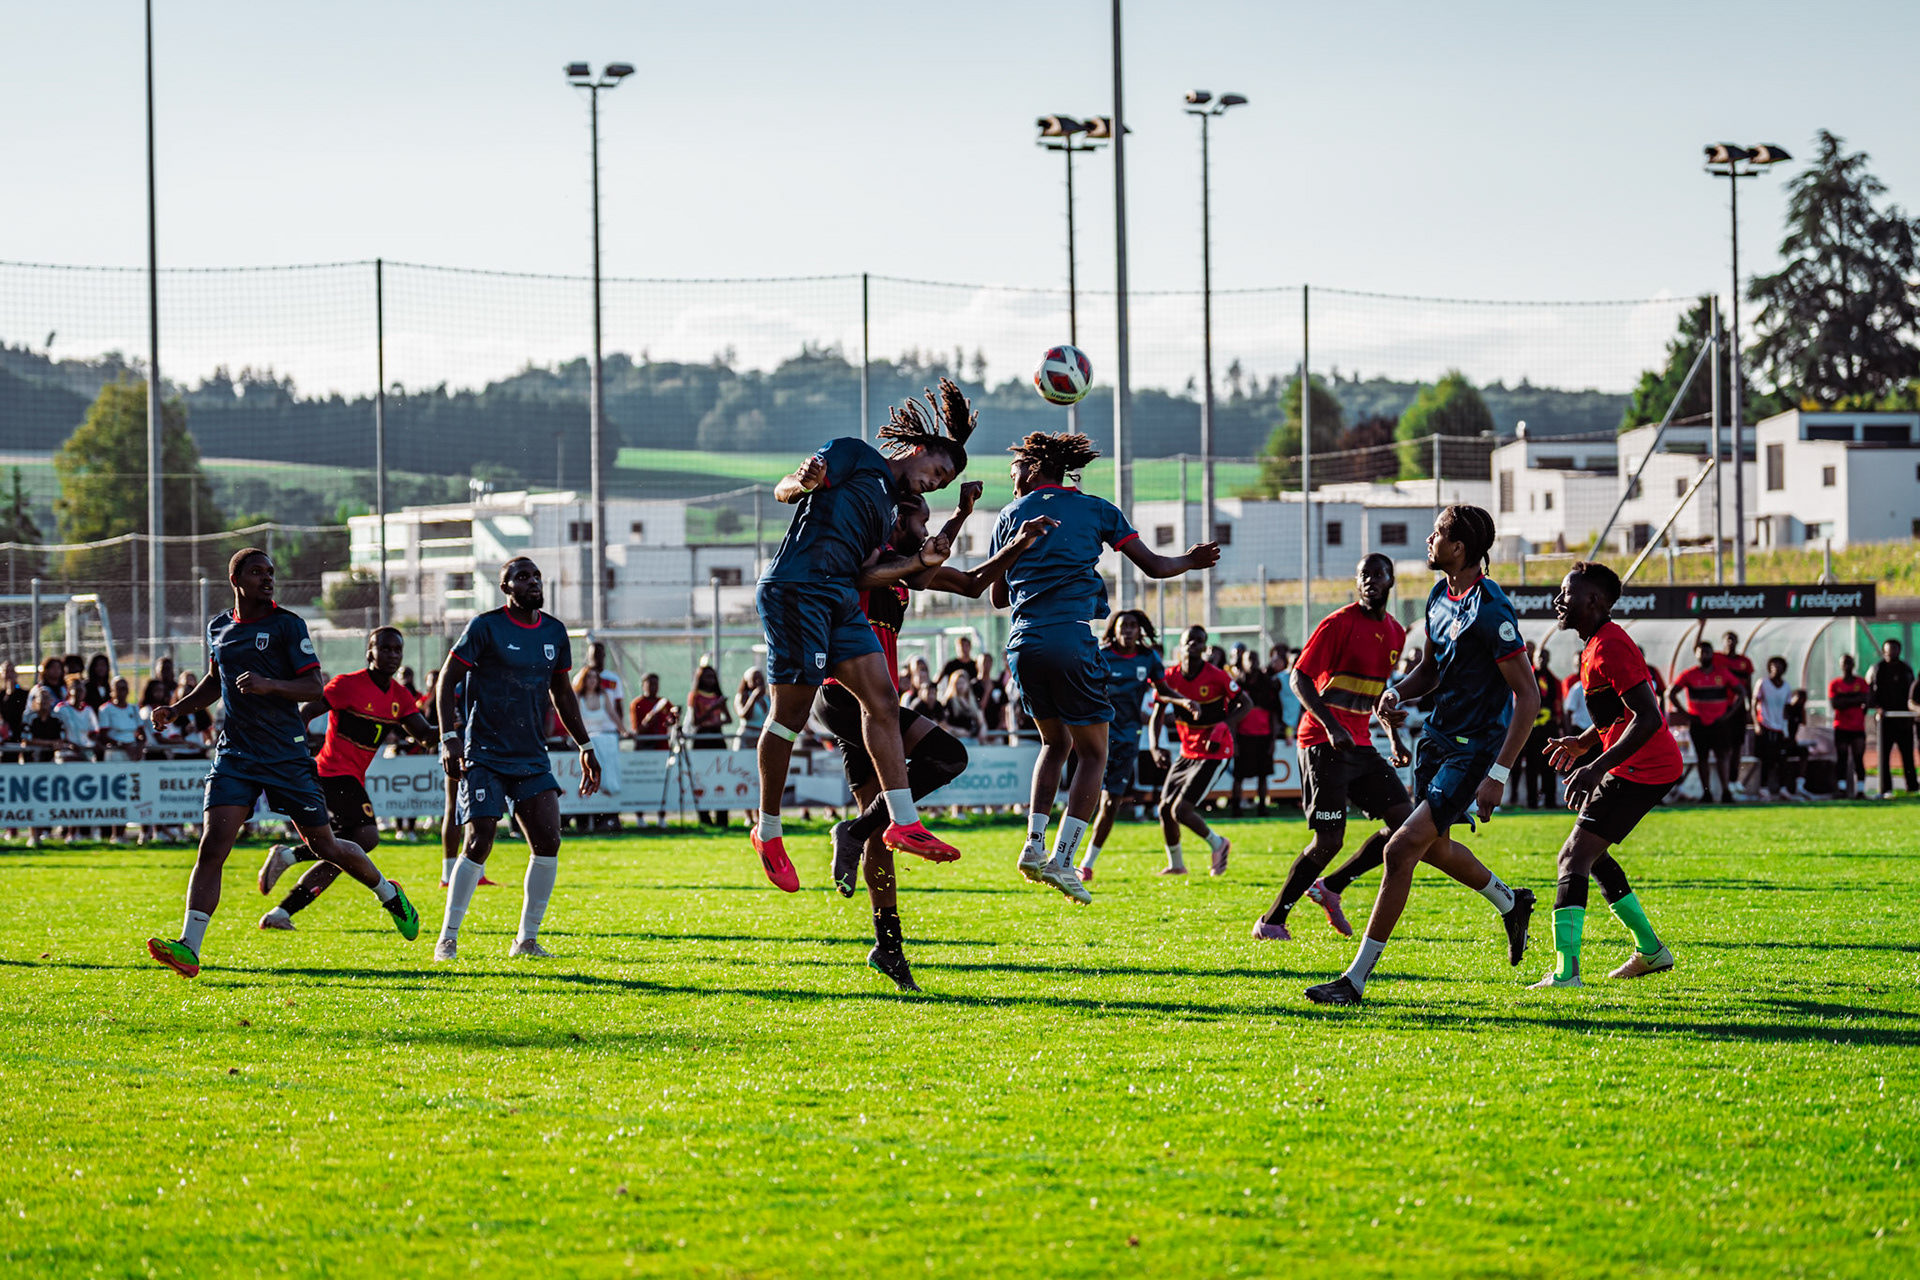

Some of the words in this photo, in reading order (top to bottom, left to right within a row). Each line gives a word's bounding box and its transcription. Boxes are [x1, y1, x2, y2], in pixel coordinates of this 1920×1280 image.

[1507, 590, 1552, 615] lsport
[1701, 590, 1765, 614] realsport
[1800, 589, 1862, 613] realsport
[374, 724, 383, 744] 7
[949, 771, 1018, 790] asco.ch
[49, 807, 127, 820] SANITAIRE
[1316, 811, 1342, 820] RIBAG
